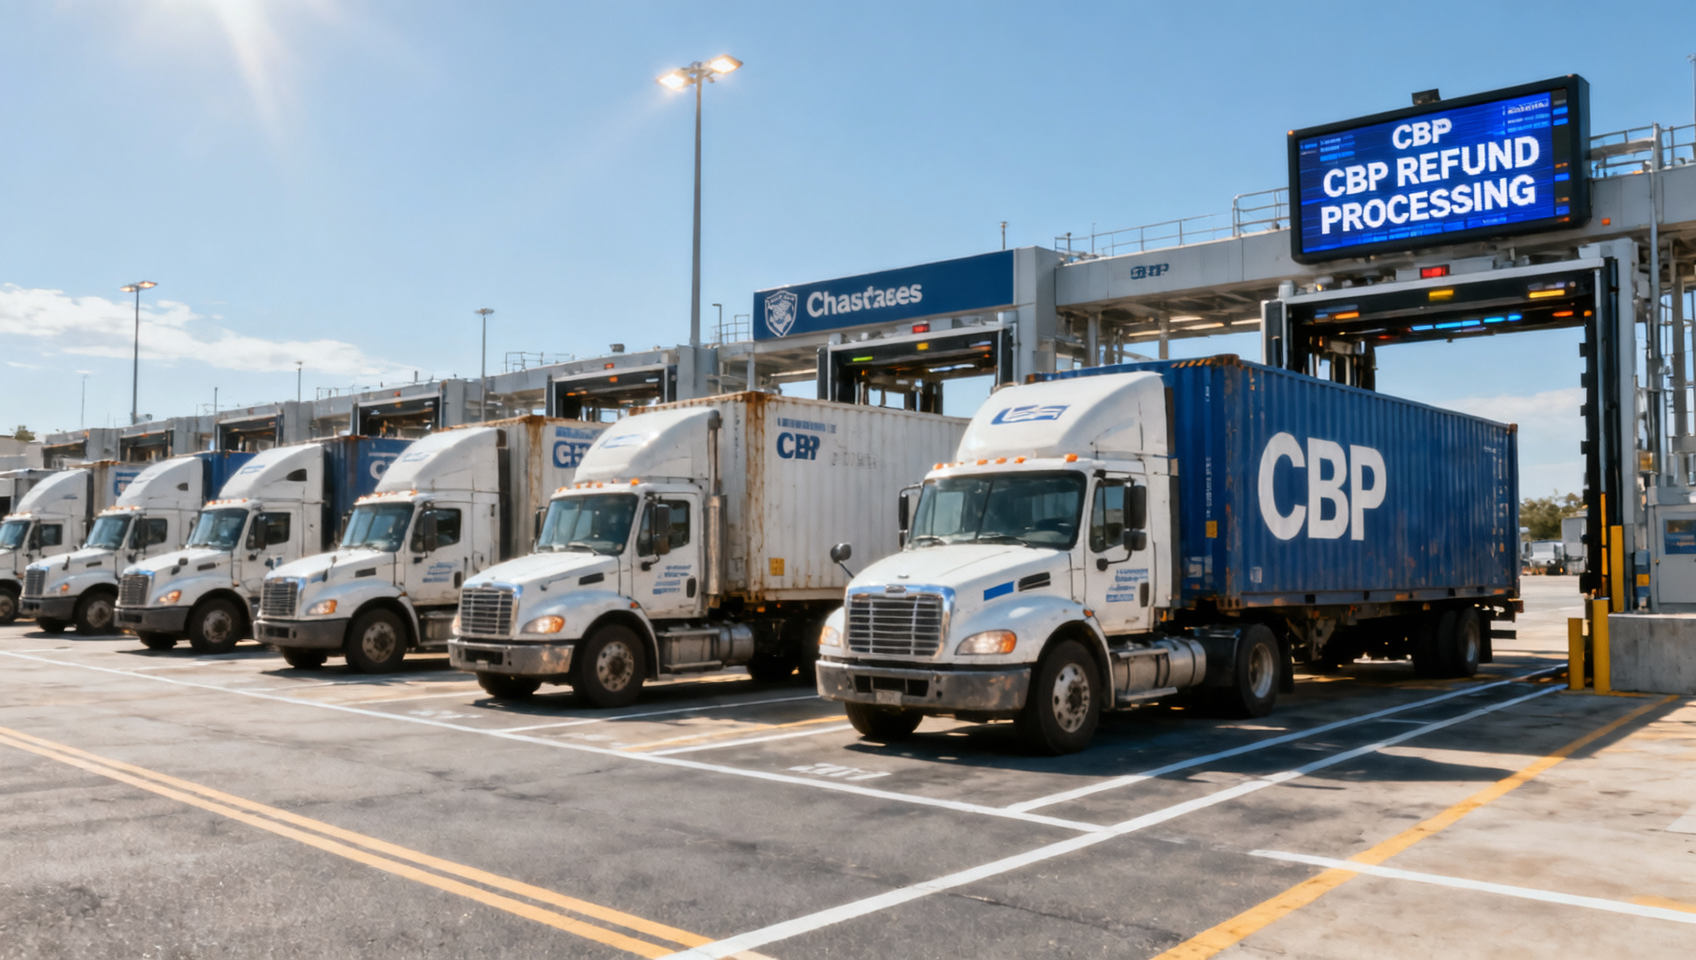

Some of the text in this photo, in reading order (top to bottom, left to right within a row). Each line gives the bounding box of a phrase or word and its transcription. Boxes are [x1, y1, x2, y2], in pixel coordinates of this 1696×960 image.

[1392, 118, 1453, 150] CBP
[1323, 161, 1388, 198] CBP
[1396, 135, 1540, 187] REFUND
[1320, 174, 1537, 235] PROCESSING
[1258, 431, 1387, 541] CBP
